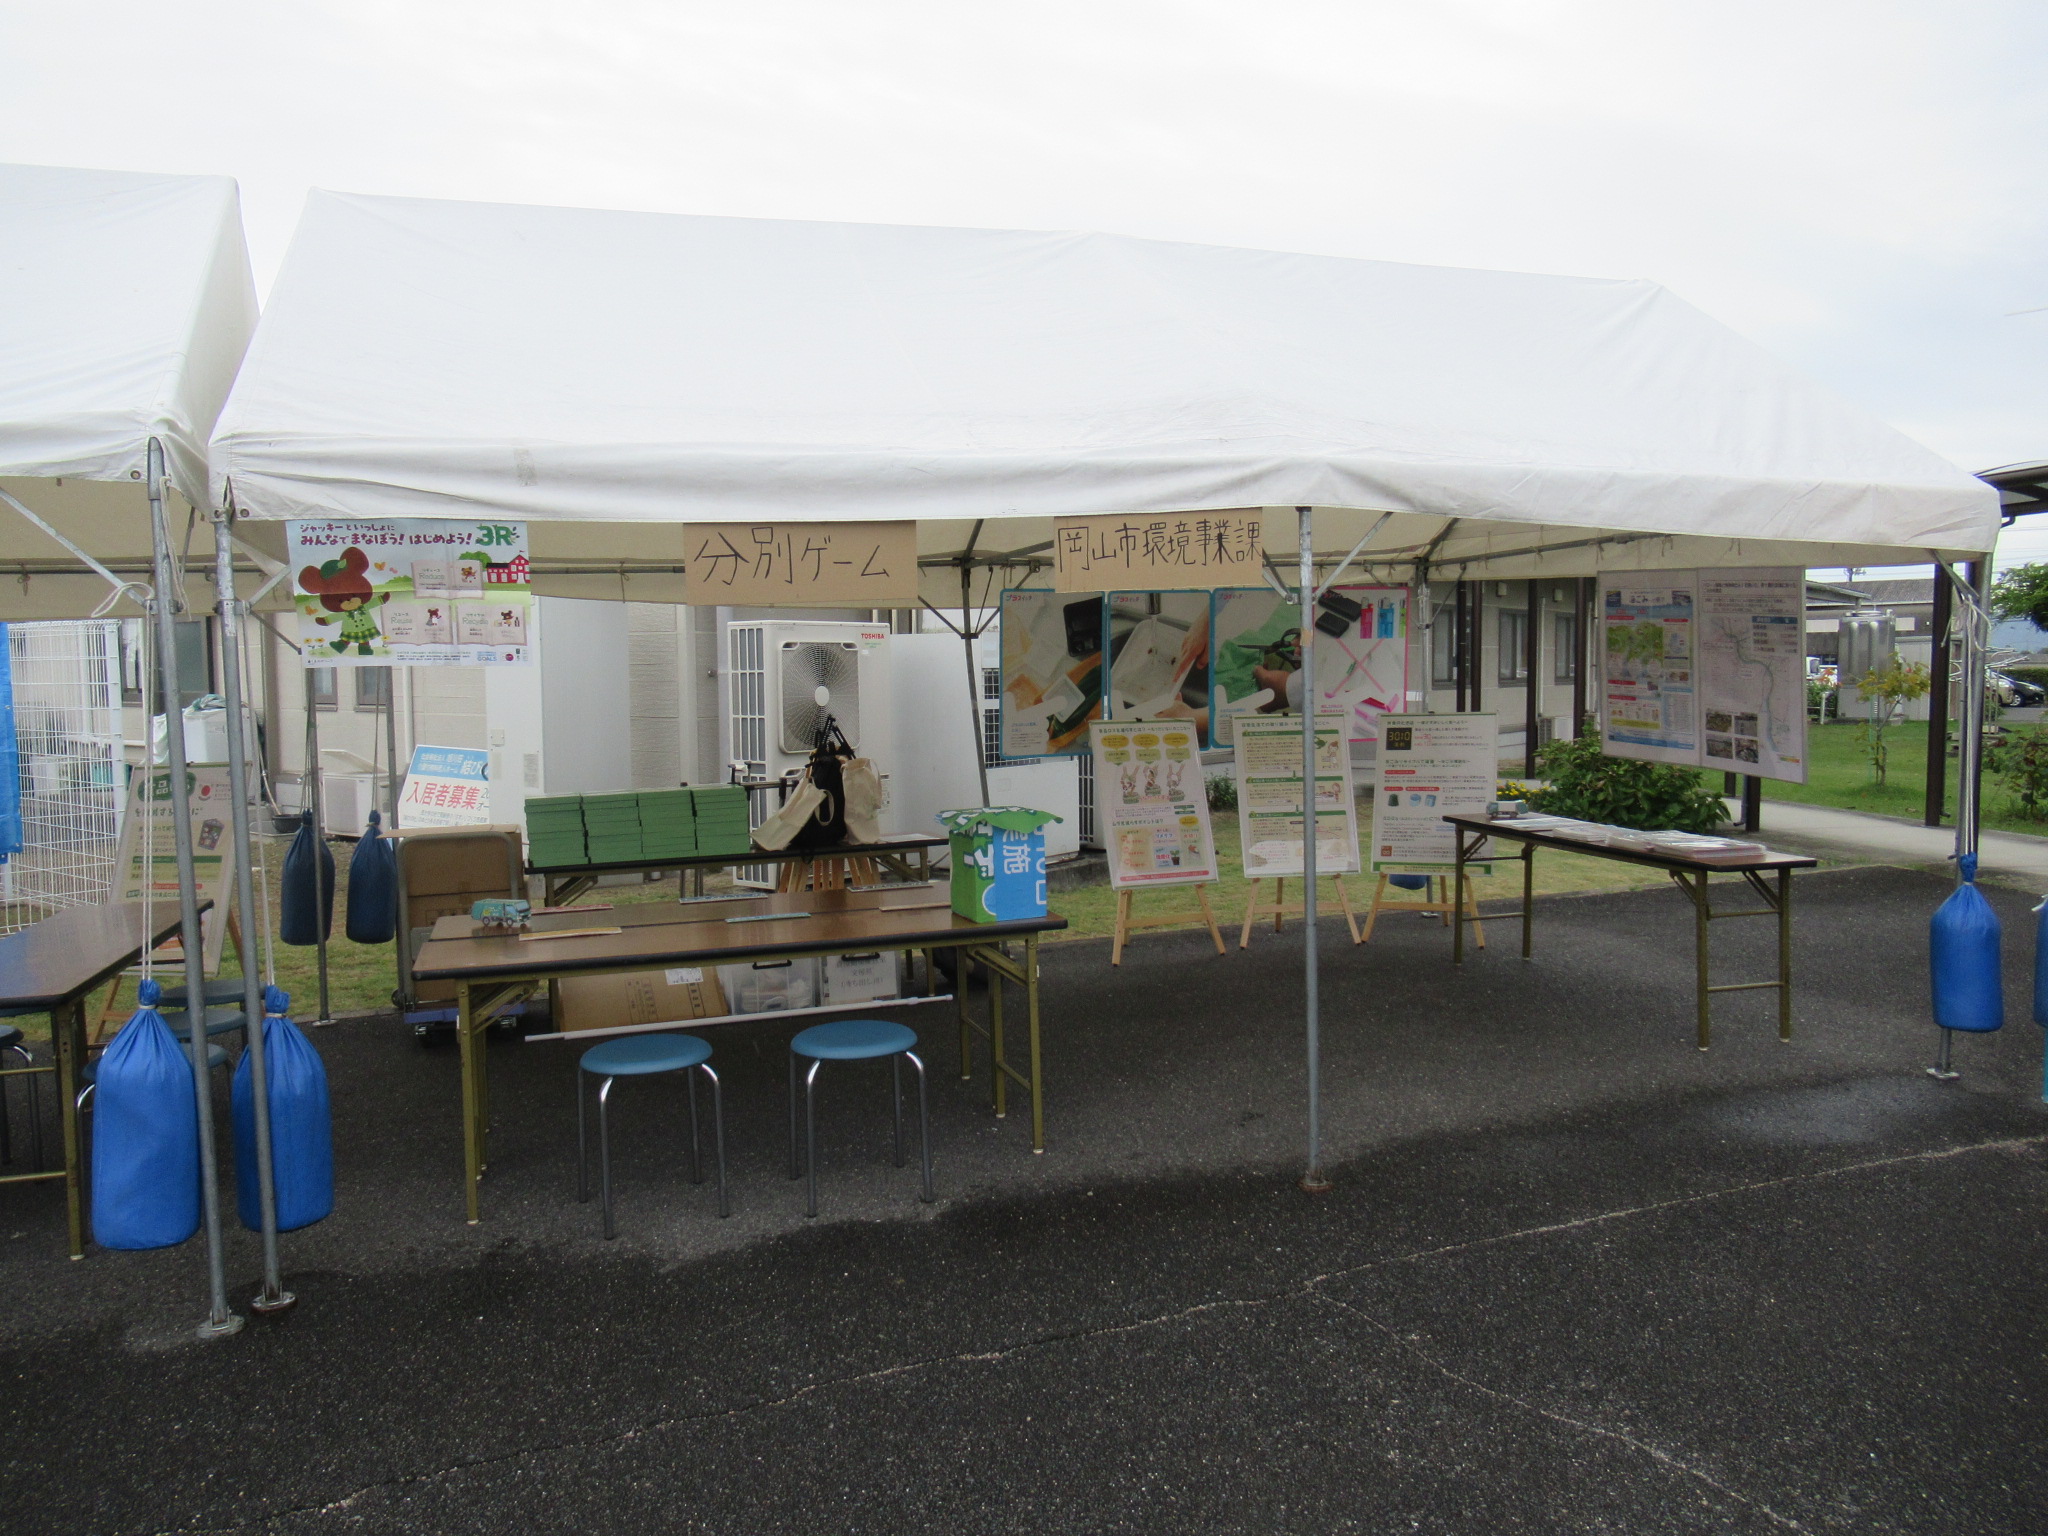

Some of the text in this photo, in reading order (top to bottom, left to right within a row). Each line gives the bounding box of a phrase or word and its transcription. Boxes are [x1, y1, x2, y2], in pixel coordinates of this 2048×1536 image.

[300, 523, 396, 533] ジャッキーといっしょに
[475, 524, 514, 546] 3R
[694, 527, 890, 585] 分別ゲーム
[1058, 518, 1261, 573] 岡山市環境事業課
[418, 572, 445, 580] Reduce
[1388, 731, 1411, 741] 3010
[406, 782, 480, 810] 入居者募集
